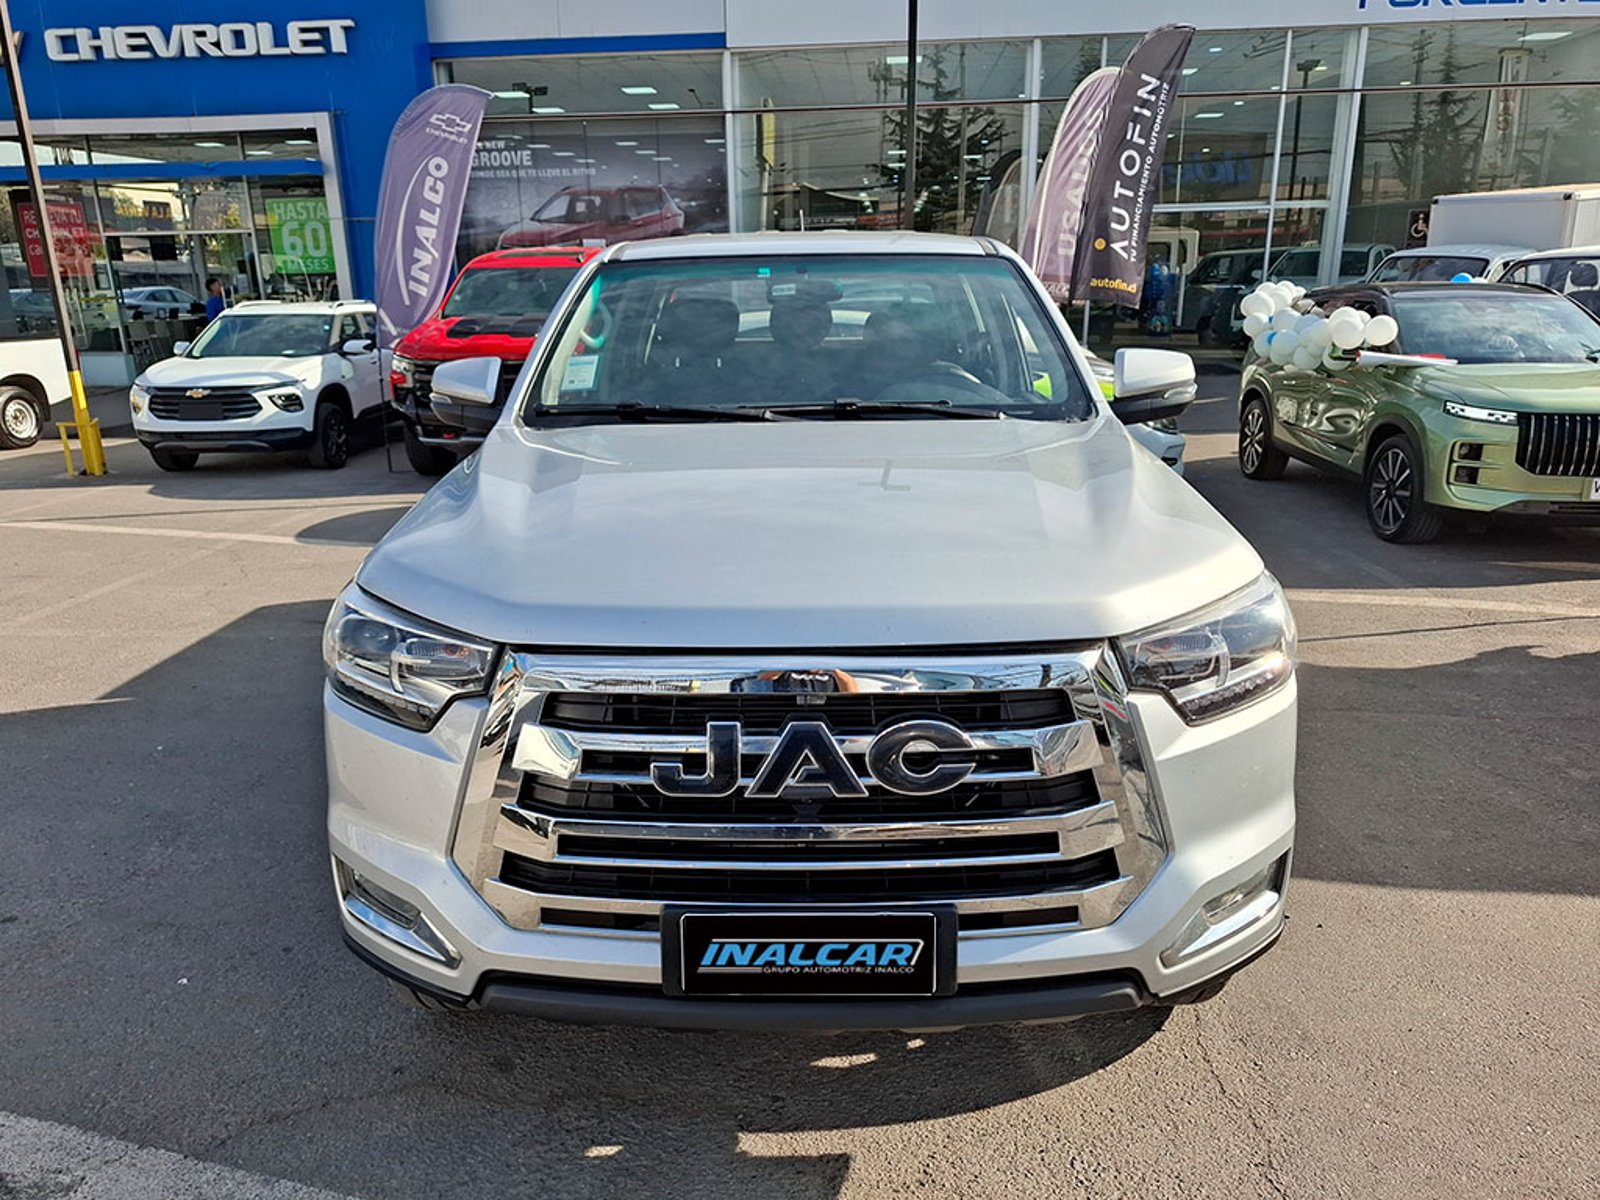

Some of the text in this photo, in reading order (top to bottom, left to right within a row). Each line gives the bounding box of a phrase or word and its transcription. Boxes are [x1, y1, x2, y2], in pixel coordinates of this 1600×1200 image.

[44, 19, 356, 62] CHEVROLET
[1110, 73, 1161, 260] AUTOFIN
[1131, 156, 1154, 247] FINANCIAMIENTO
[1148, 82, 1170, 154] AUTOMOTRIZ
[272, 202, 327, 220] HASTA
[408, 156, 449, 297] INALCO
[282, 221, 328, 257] 60
[649, 719, 978, 798] JAC
[700, 943, 914, 966] INALCAR
[763, 965, 915, 974] GRUPO AUTOMOTRIZ INALCO
